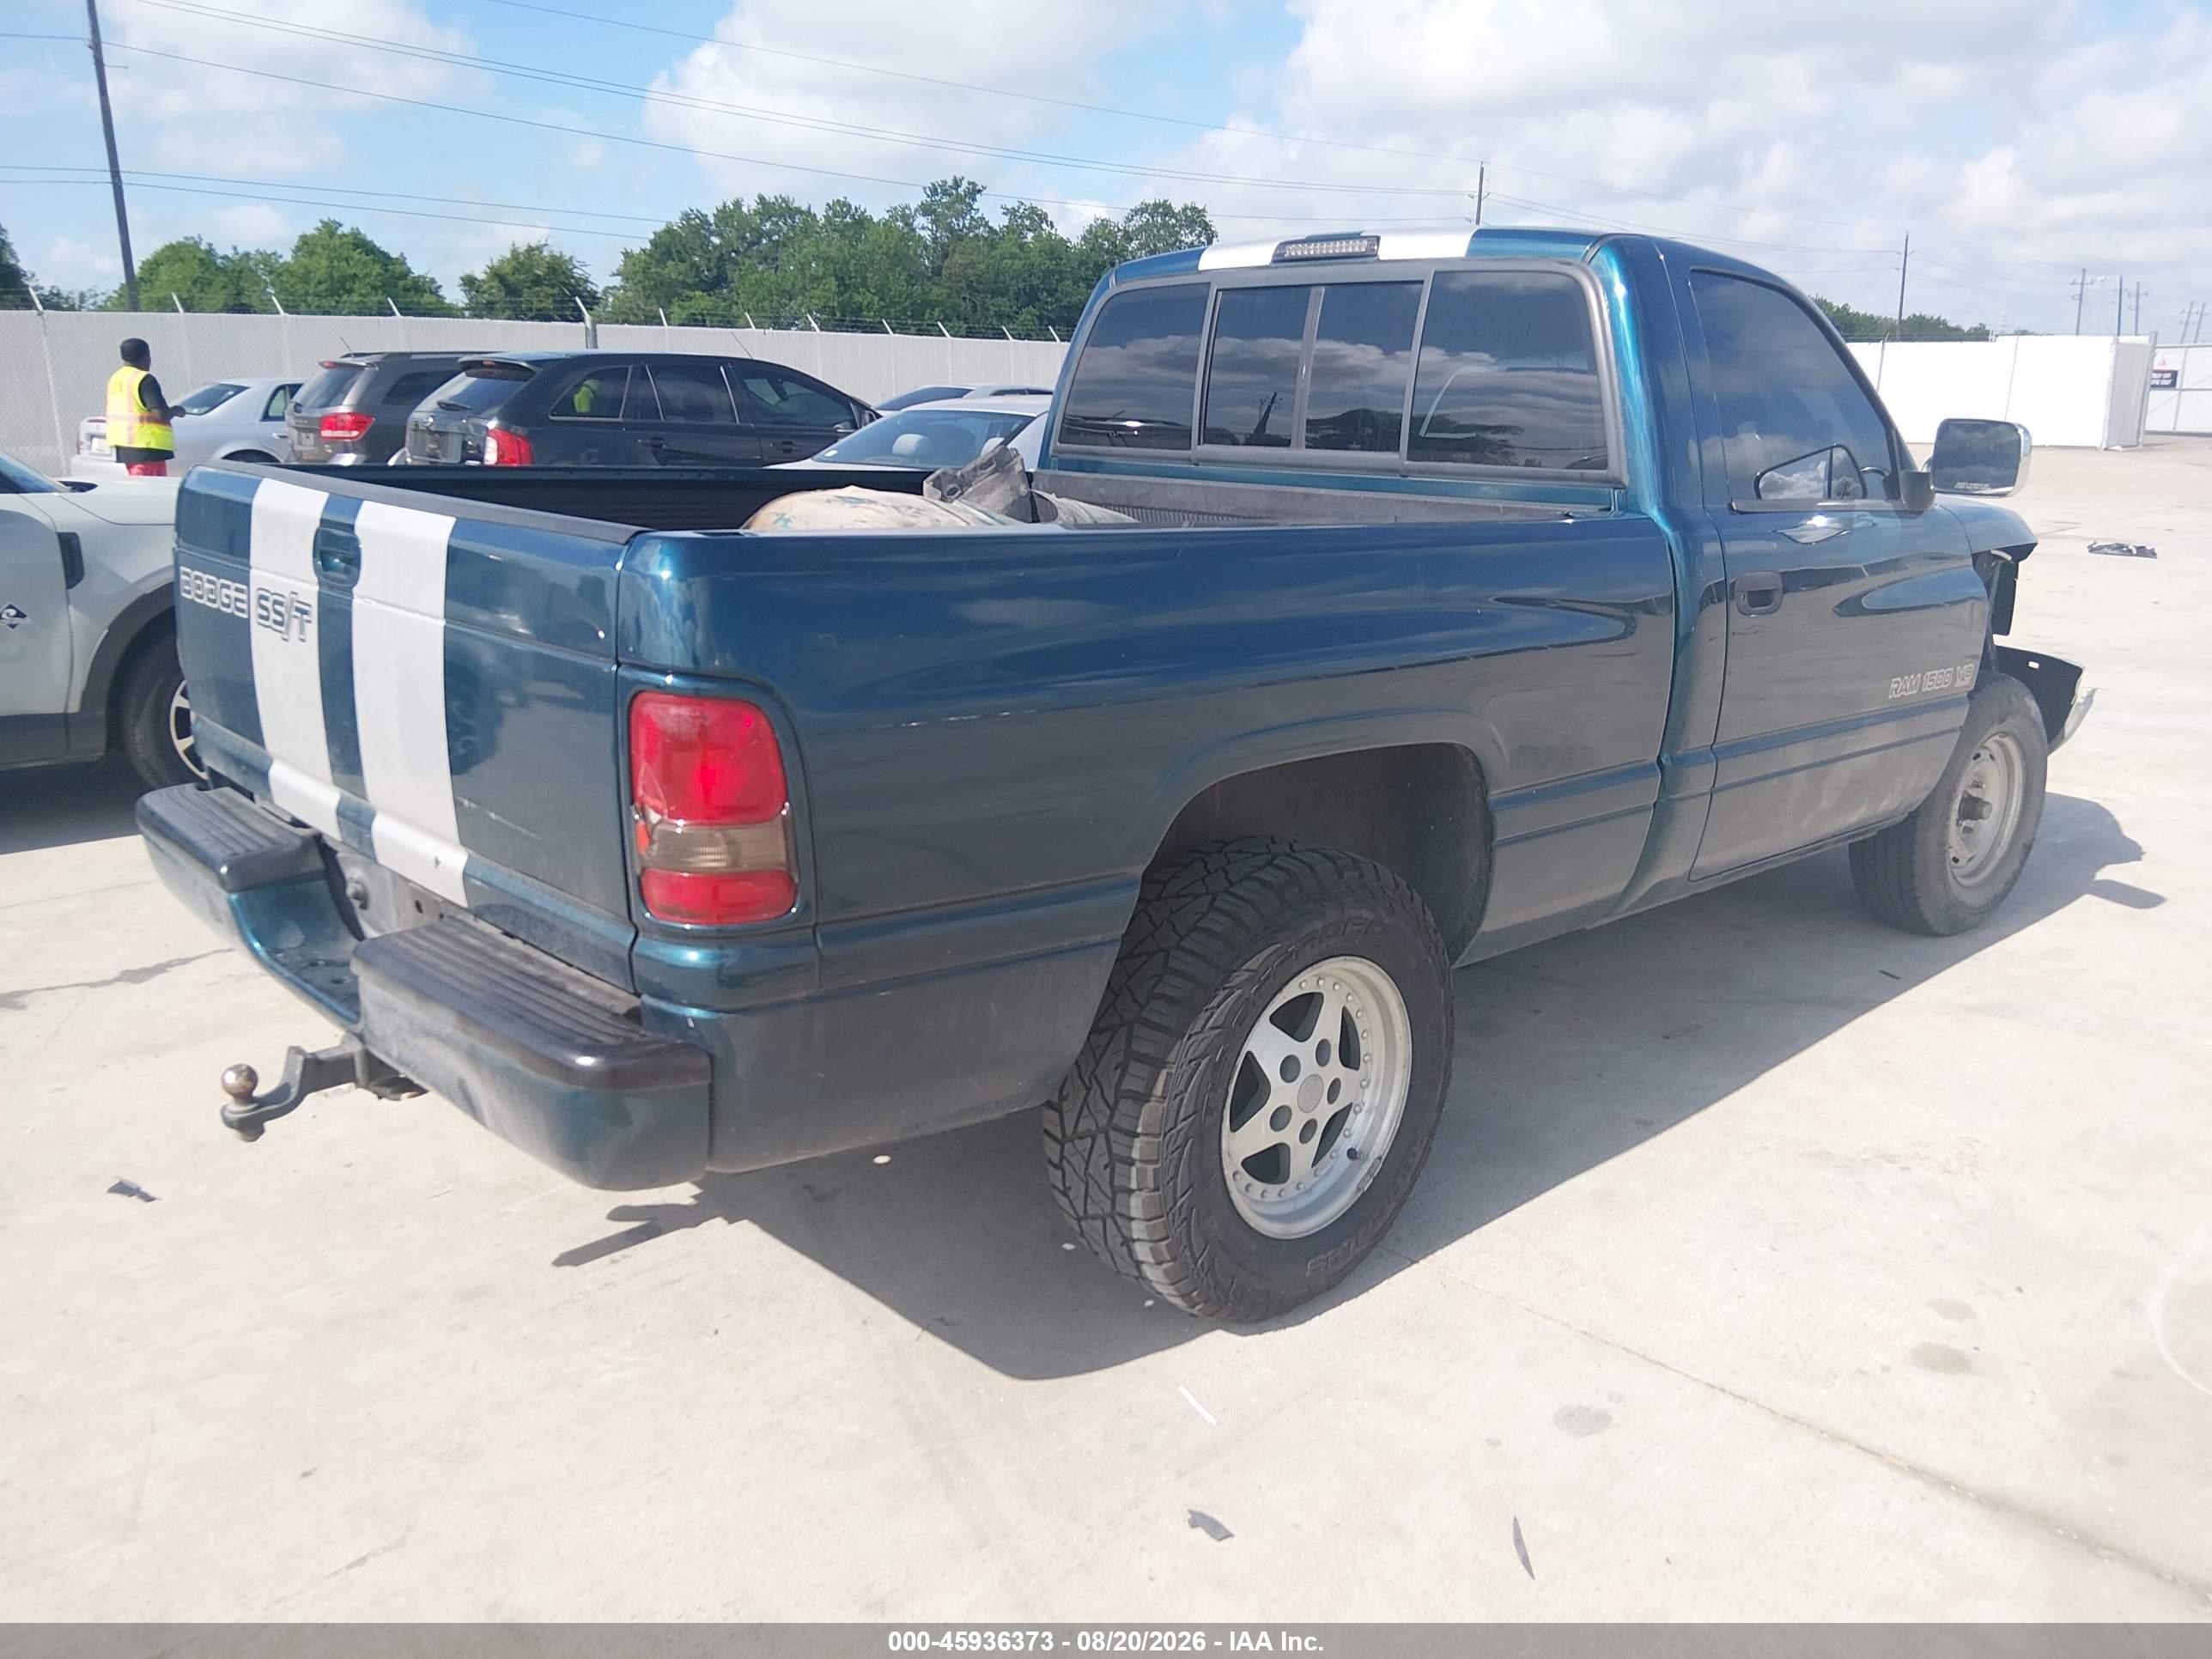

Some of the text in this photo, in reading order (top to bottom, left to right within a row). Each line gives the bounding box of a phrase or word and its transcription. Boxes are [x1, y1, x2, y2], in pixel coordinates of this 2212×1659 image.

[179, 566, 312, 642] DODGE SS/T
[1889, 674, 1921, 699] RAM
[1923, 668, 1954, 692] 1500
